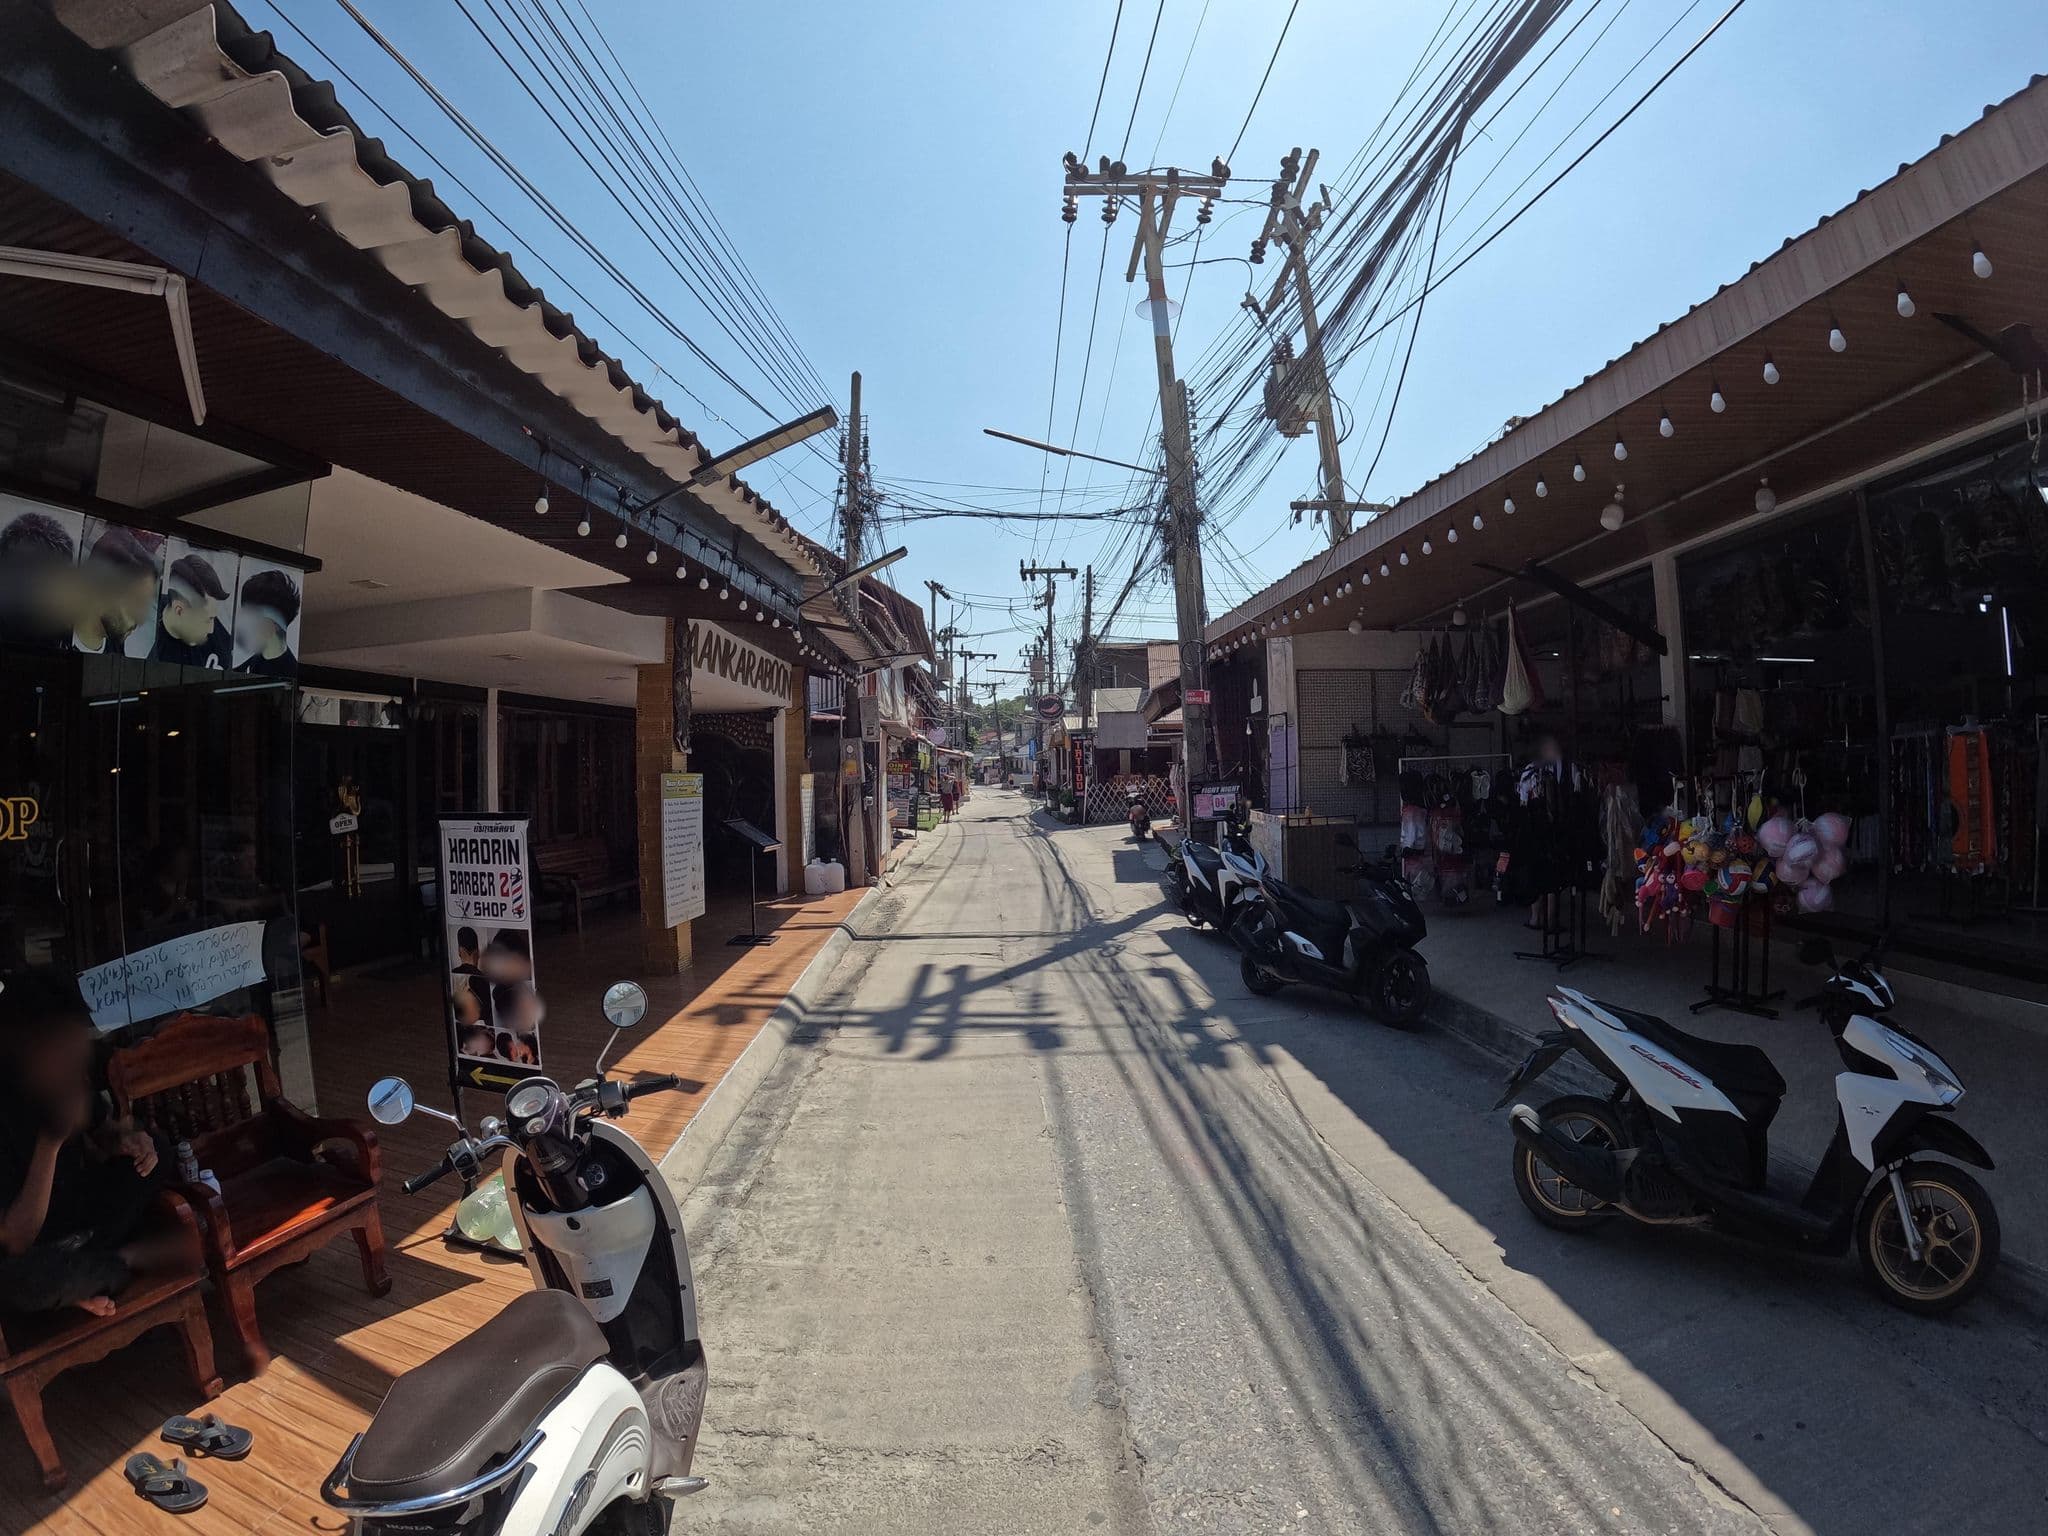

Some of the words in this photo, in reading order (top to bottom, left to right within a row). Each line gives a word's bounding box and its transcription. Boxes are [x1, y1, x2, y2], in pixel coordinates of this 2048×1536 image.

[687, 622, 793, 702] AANKARABOON
[1220, 785, 1241, 793] NIGHT
[1215, 797, 1226, 808] 04
[334, 818, 353, 828] OPEN
[448, 837, 520, 866] HAADRIN
[449, 870, 496, 897] BARBER
[499, 872, 510, 898] 2
[474, 901, 508, 918] SHOP
